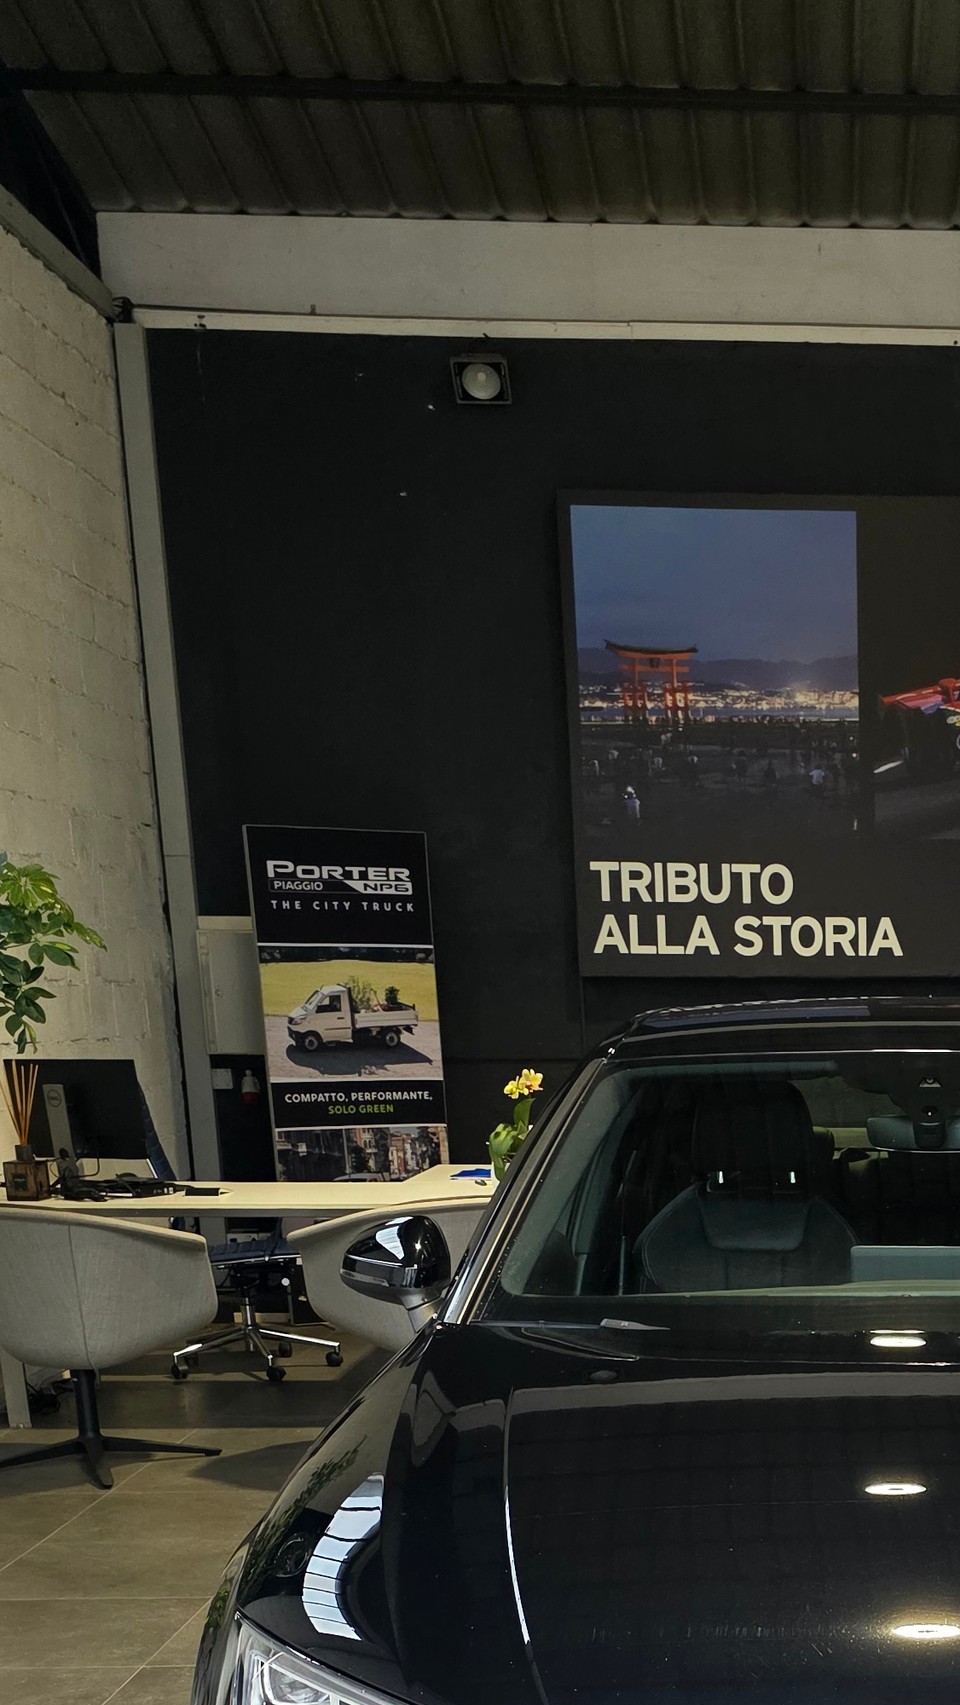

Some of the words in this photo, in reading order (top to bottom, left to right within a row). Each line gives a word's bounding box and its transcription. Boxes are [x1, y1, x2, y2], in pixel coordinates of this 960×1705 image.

[266, 860, 411, 881] PORTER
[273, 881, 323, 891] PIAGGIO
[363, 882, 409, 893] NP6
[590, 861, 794, 905] TRIBUTO
[271, 900, 301, 910] THE
[312, 901, 351, 911] CITY
[361, 902, 414, 912] TRUCK
[593, 914, 720, 955] ALLA
[733, 916, 904, 957] STORIA
[284, 1092, 349, 1103] COMPATTO,
[351, 1091, 433, 1102] PERFORMANTE,
[328, 1105, 356, 1114] SOLO
[358, 1104, 394, 1114] GREEN
